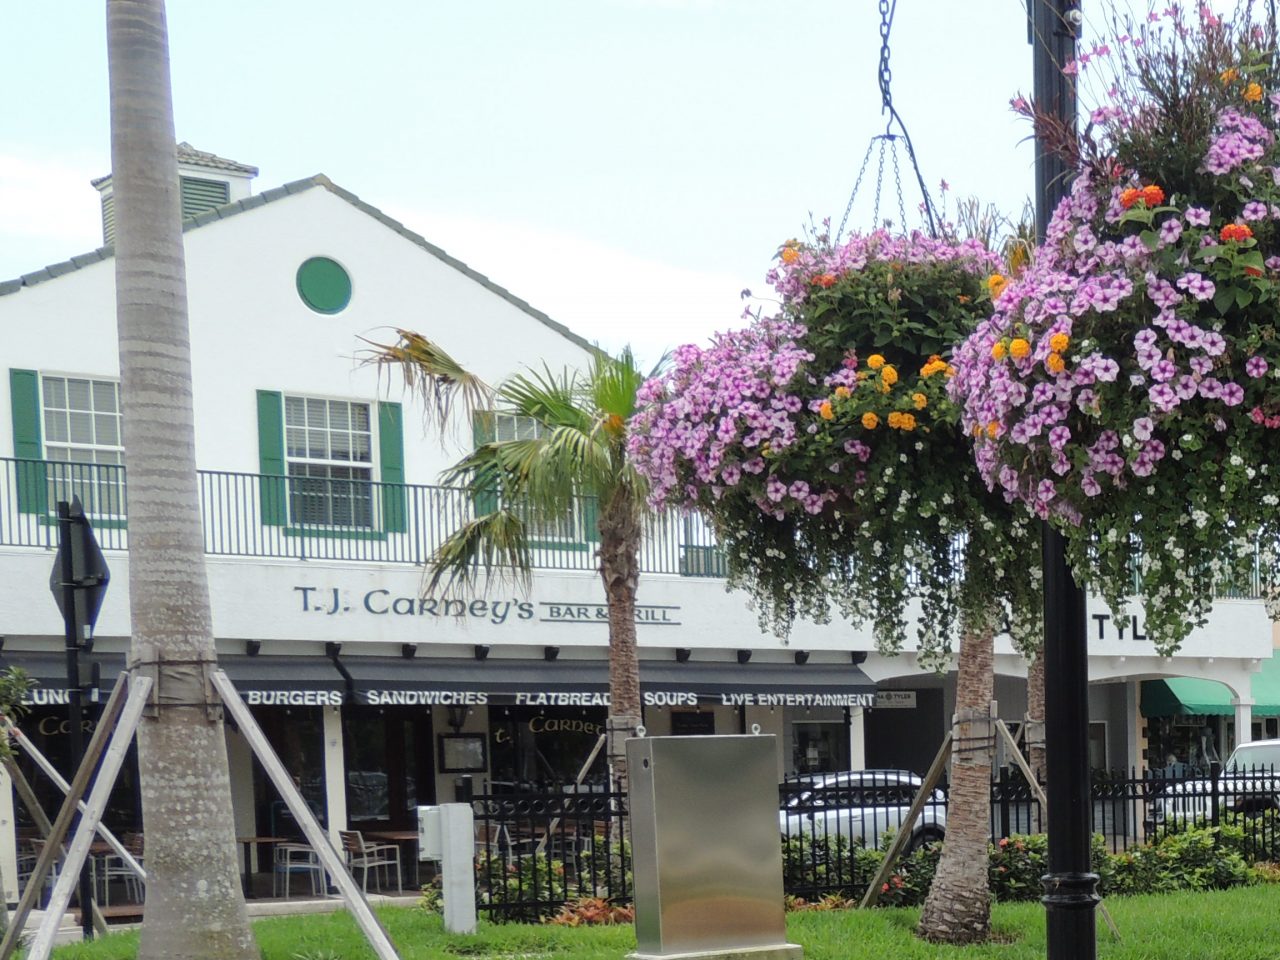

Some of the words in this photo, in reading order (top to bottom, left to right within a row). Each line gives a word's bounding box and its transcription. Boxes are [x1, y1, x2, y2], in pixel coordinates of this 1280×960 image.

[294, 586, 350, 615] T.J.
[549, 606, 591, 619] BAR
[596, 607, 609, 619] &
[634, 609, 671, 622] RILL
[249, 691, 343, 705] BURGERS
[366, 690, 489, 705] SANDWICHES
[643, 692, 698, 706] SOUPS
[721, 694, 754, 706] LIVE
[758, 694, 875, 707] ENTERTAINMENT
